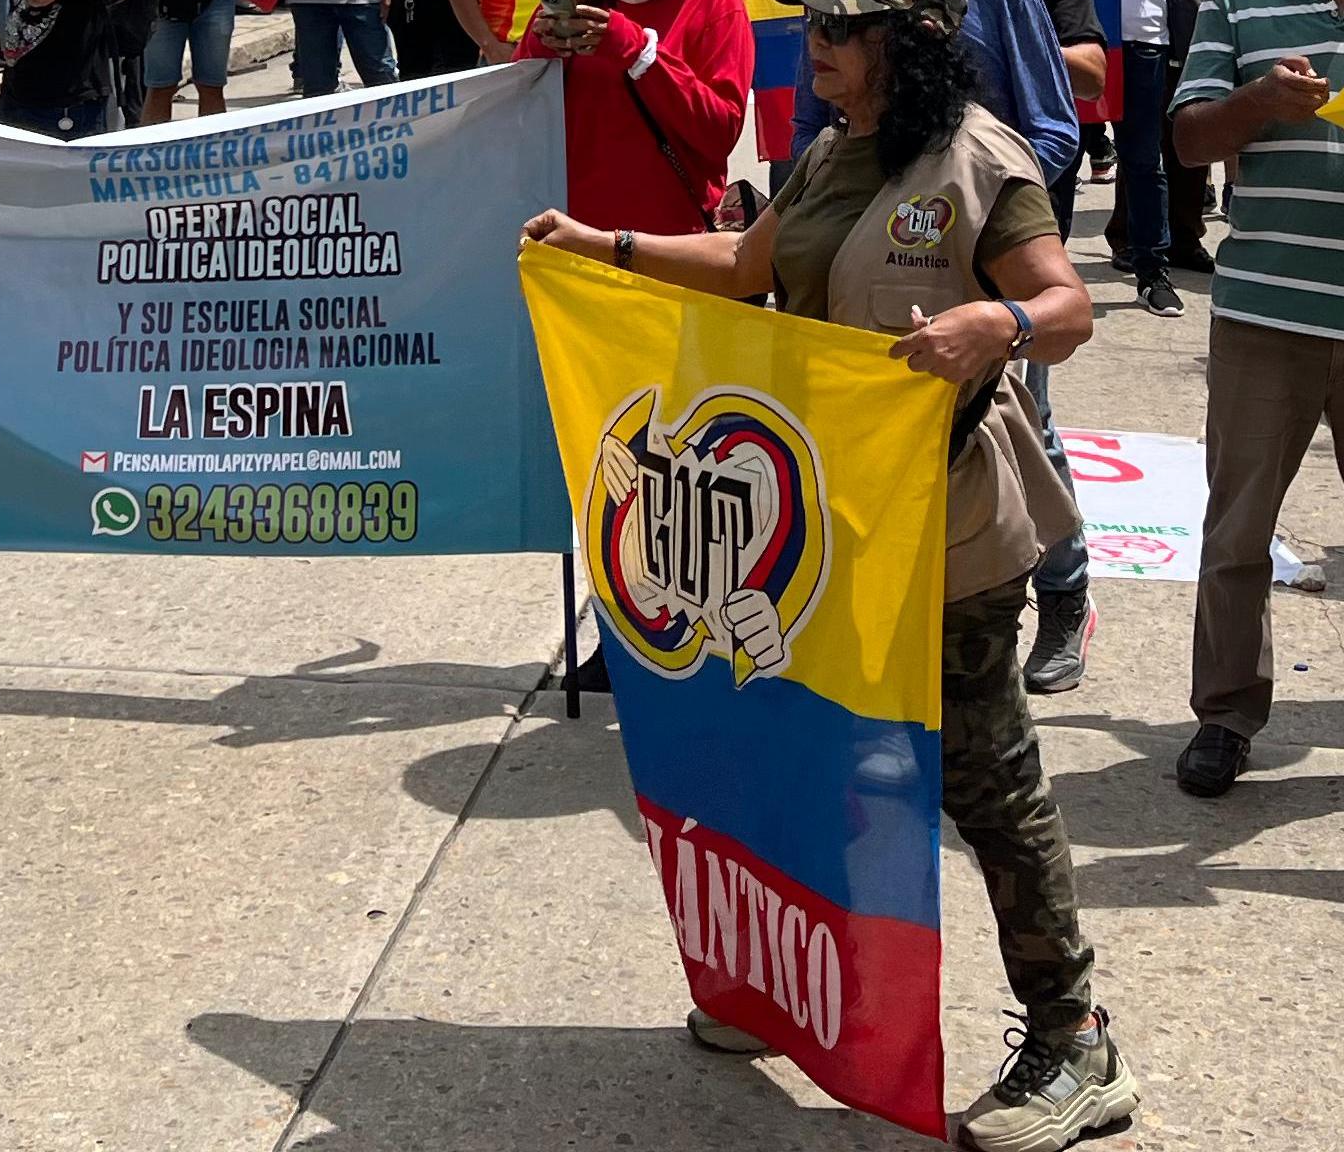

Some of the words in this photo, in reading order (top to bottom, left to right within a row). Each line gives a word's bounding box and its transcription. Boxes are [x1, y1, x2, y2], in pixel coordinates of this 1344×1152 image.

[88, 132, 271, 174] PERSONERÍA
[88, 167, 262, 204] MATRICULA
[294, 142, 410, 185] 847839
[146, 200, 256, 240] OFERTA
[262, 192, 366, 238] SOCIAL
[98, 236, 231, 283] POLÍTICA
[117, 301, 135, 335] Y
[141, 300, 174, 334] SU
[182, 298, 291, 334] ESCUELA
[298, 295, 388, 332] SOCIAL
[56, 335, 171, 374] POLÍTICA
[179, 334, 310, 371] IDEOLOGIA
[318, 331, 442, 369] NACIONAL
[136, 383, 194, 440] LA
[200, 379, 354, 440] ESPINA
[144, 480, 420, 544] 3243368839
[636, 453, 762, 609] CUT
